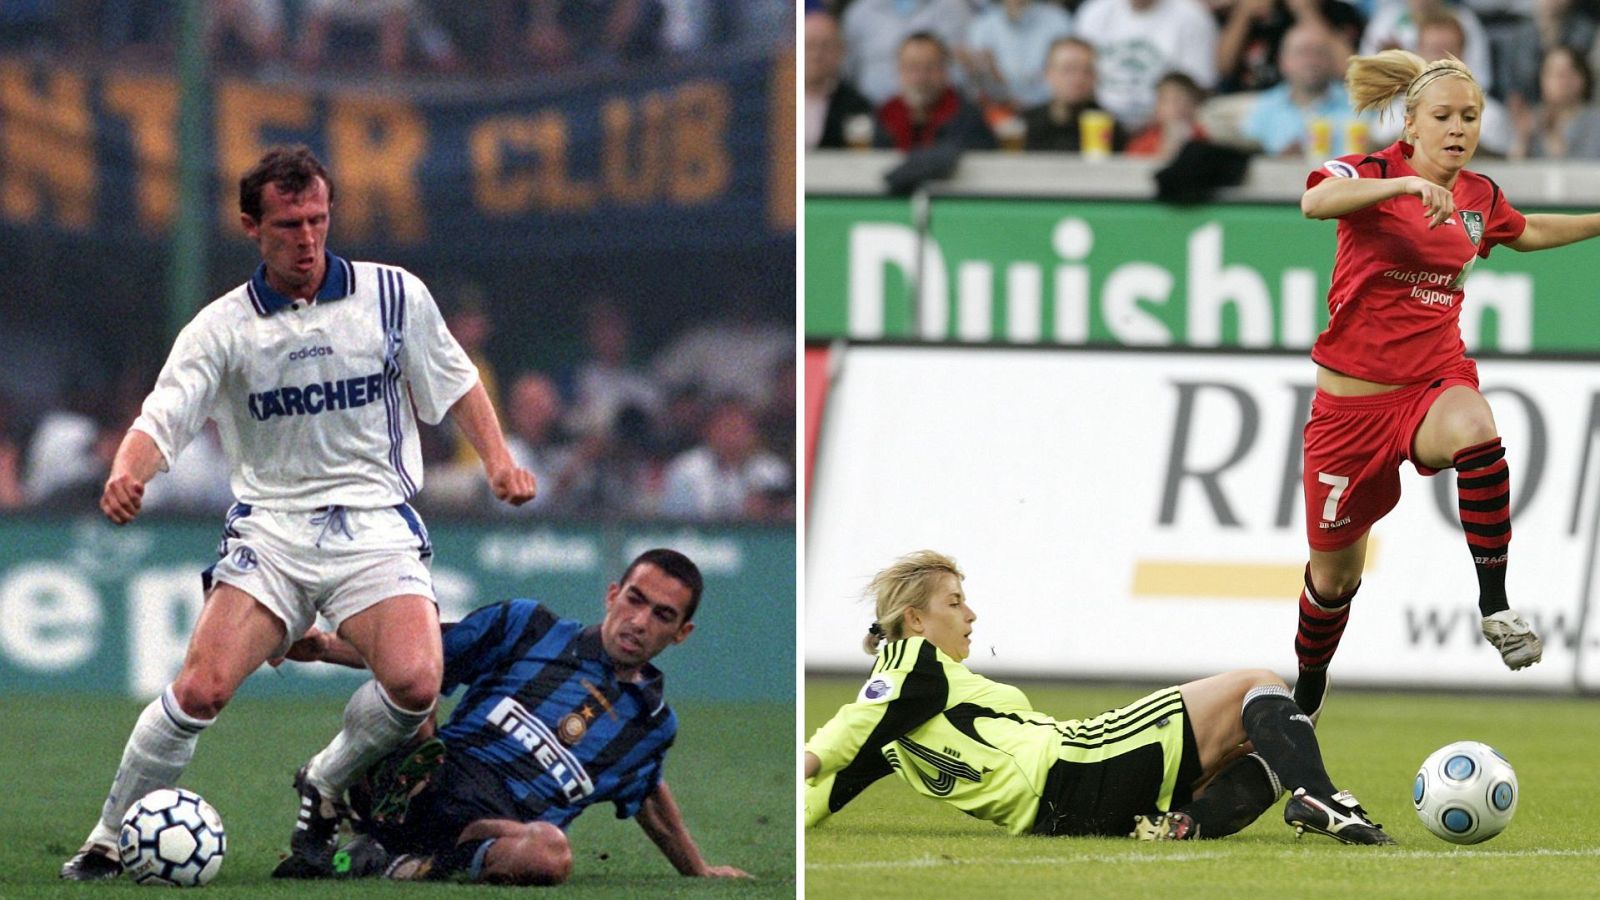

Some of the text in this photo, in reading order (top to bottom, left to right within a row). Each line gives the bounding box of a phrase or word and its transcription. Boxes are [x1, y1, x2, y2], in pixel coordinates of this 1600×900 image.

[470, 82, 732, 214] CLUB
[1384, 269, 1452, 287] duisport
[1410, 285, 1454, 307] logport
[289, 345, 334, 361] adidas
[1318, 471, 1349, 521] 7
[1474, 553, 1508, 564] DRAG
